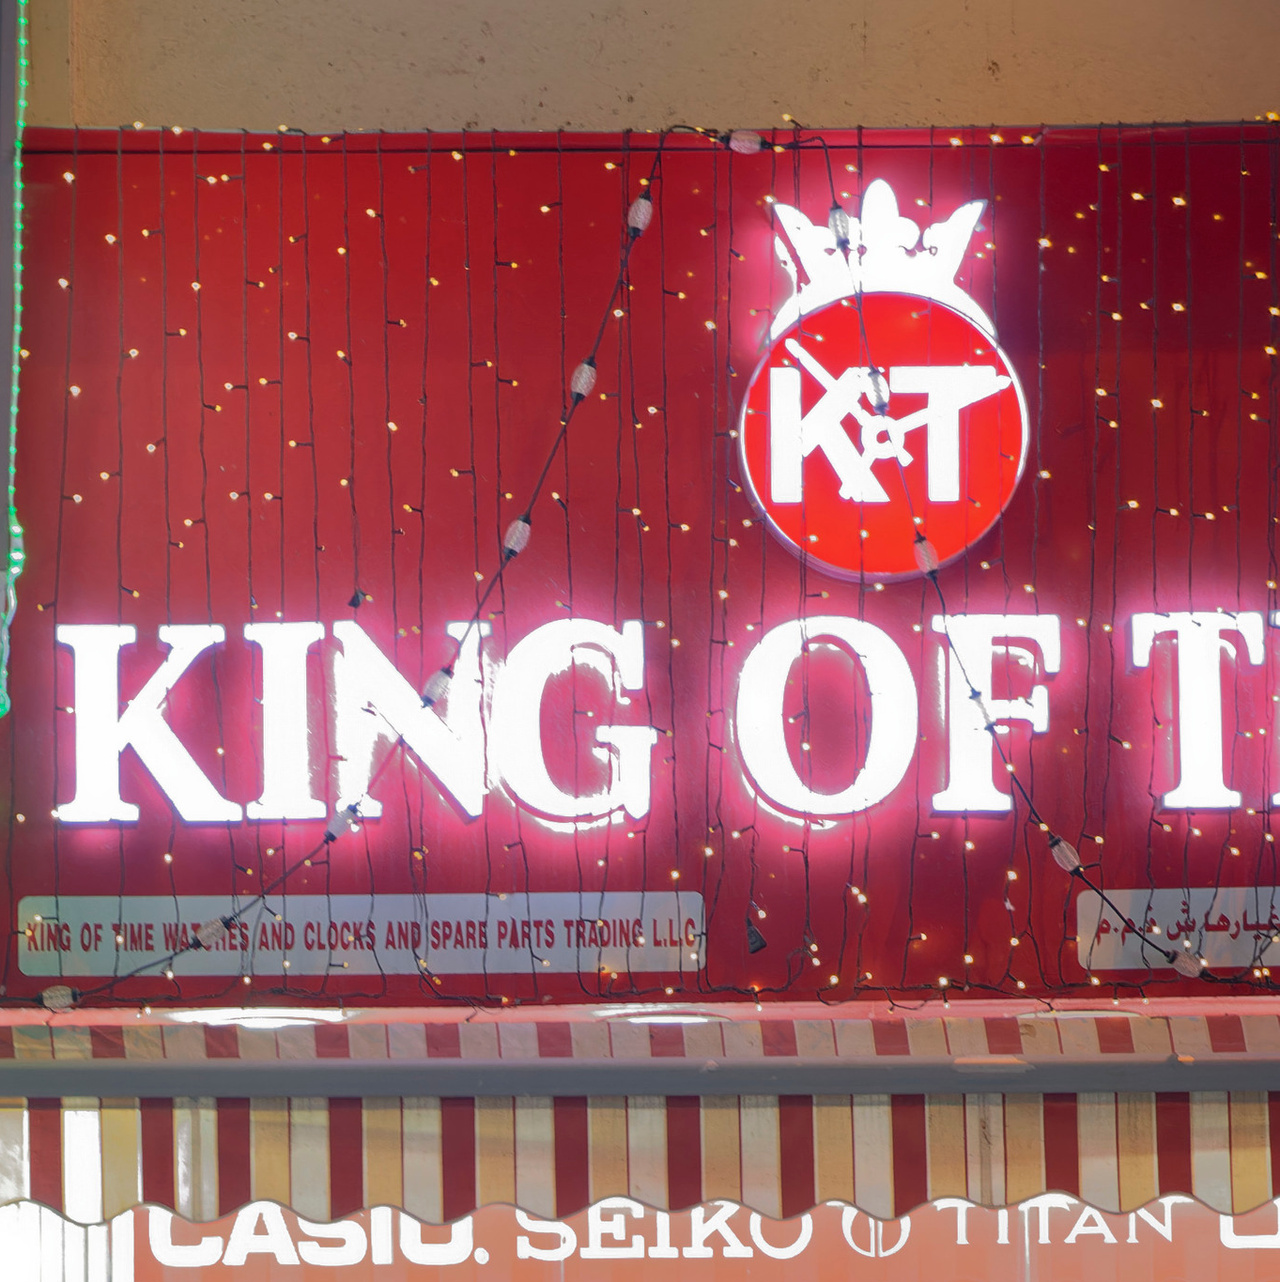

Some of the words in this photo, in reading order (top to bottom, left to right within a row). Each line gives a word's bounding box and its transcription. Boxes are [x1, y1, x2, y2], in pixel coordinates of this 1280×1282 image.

[53, 618, 656, 834] KING
[730, 612, 1063, 828] OF
[1128, 610, 1280, 810] T
[26, 922, 72, 951] KING
[80, 922, 104, 951] OF
[111, 921, 154, 951] TIME
[258, 920, 296, 951] AND
[303, 919, 376, 951] CLOCKS
[385, 920, 421, 950] AND
[430, 919, 489, 950] SPARE
[497, 917, 555, 949] PARTS
[563, 918, 645, 949] TRADING
[932, 1194, 1194, 1244] TITAN
